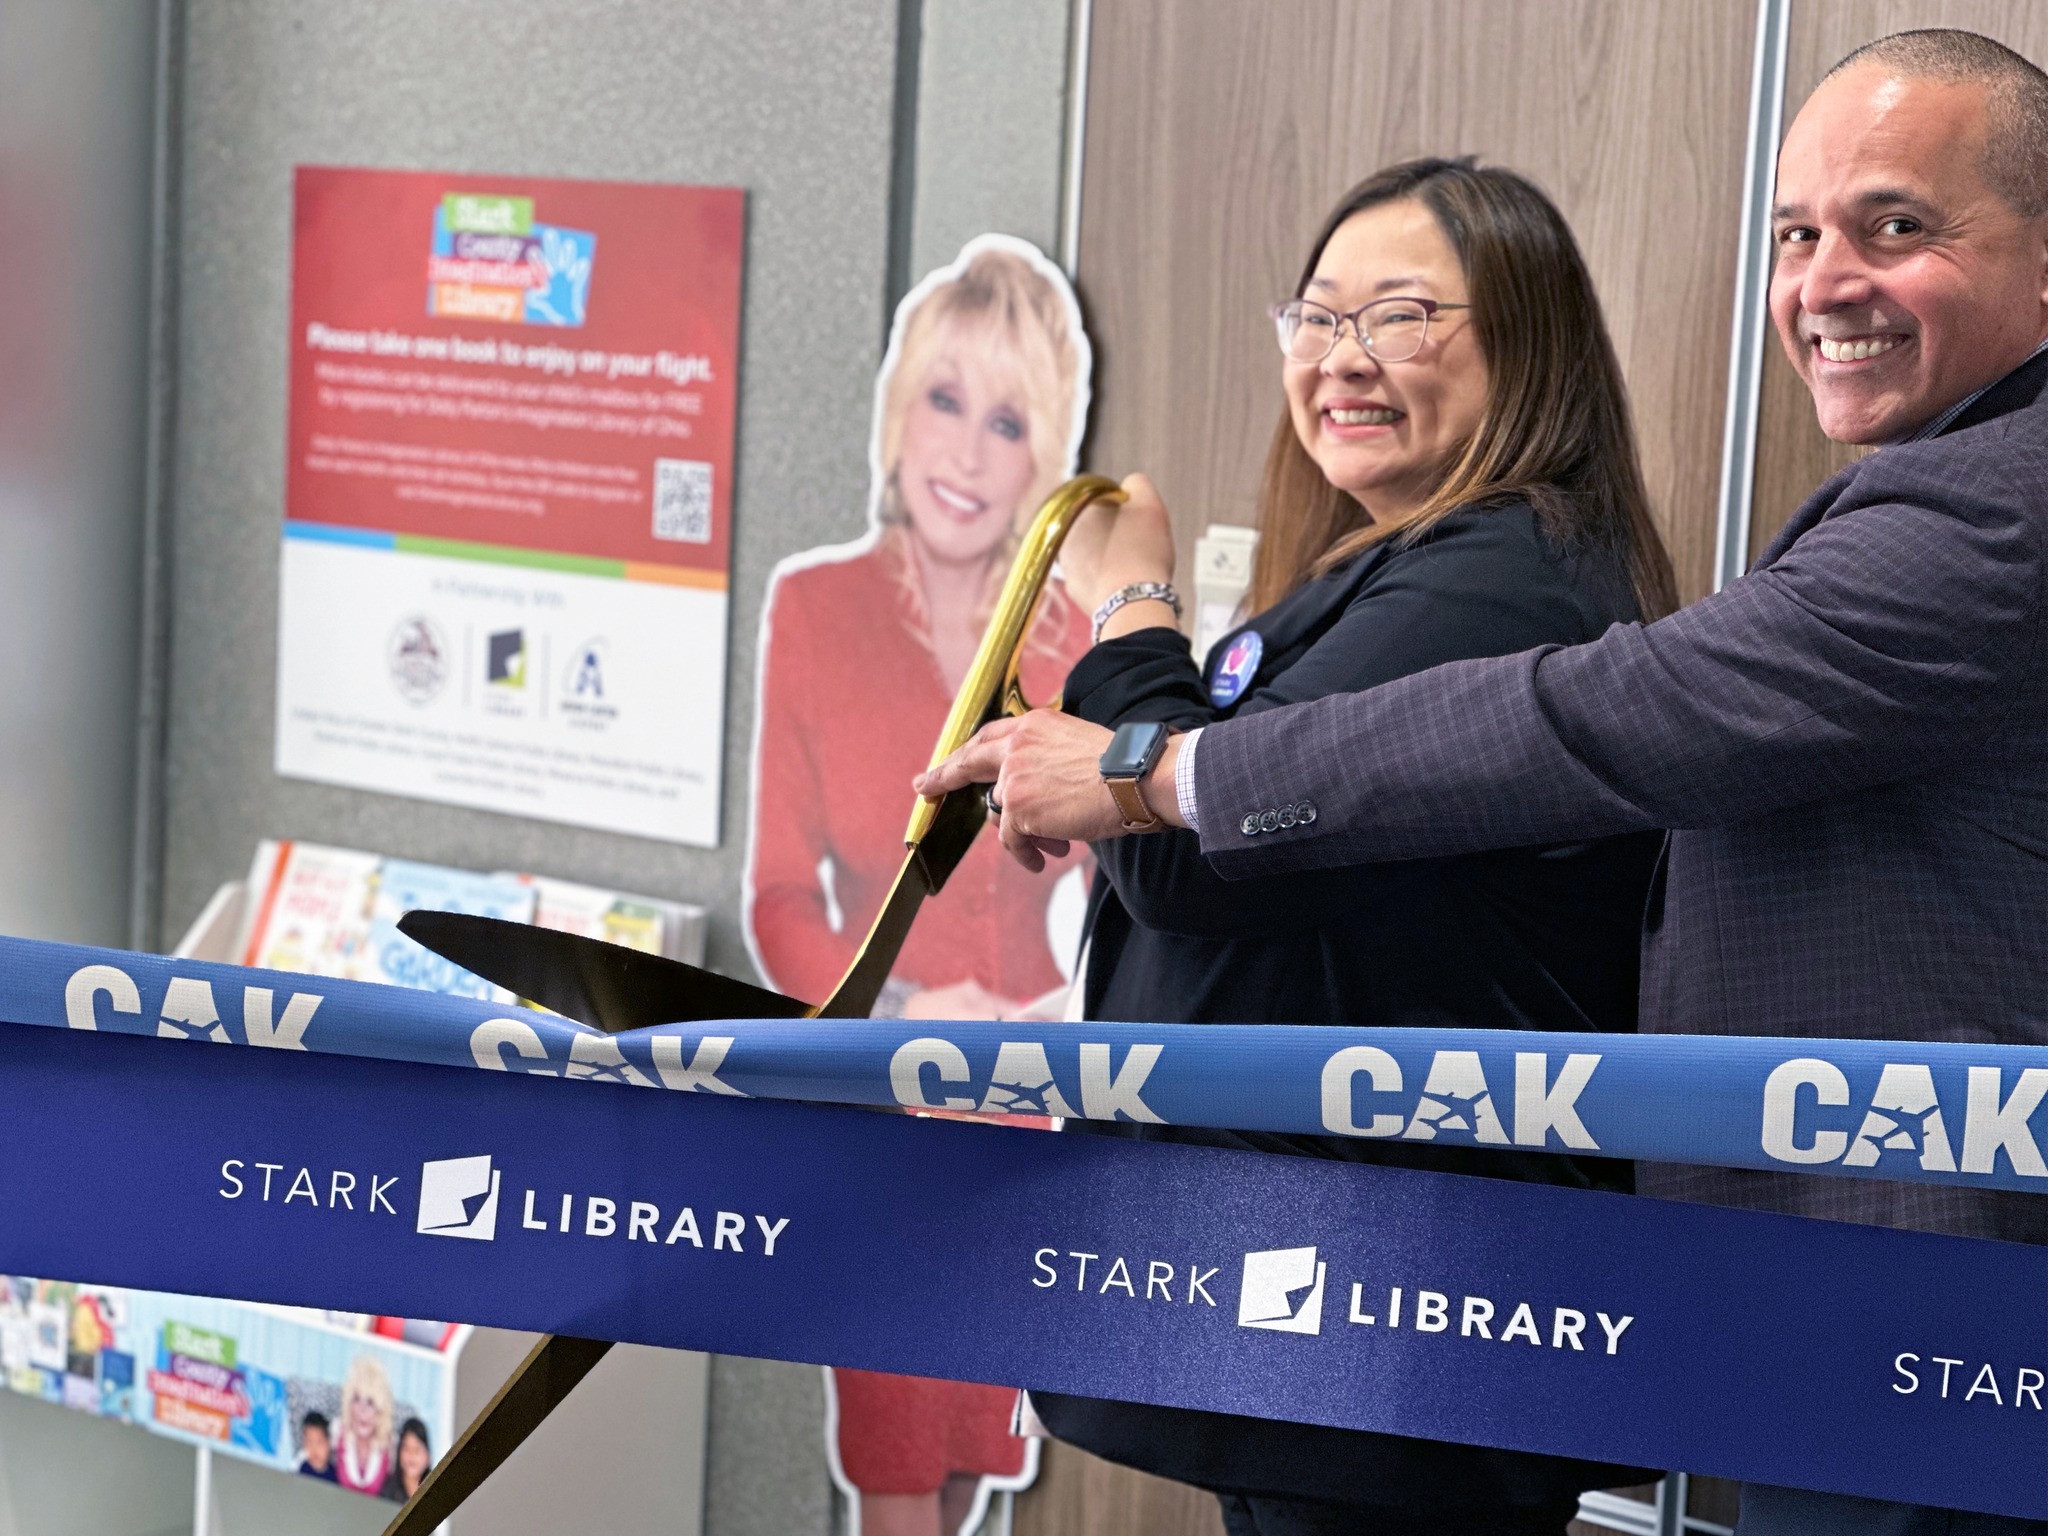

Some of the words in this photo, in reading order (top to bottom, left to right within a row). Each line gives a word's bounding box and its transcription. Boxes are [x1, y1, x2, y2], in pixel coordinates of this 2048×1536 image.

[307, 322, 366, 353] Please
[369, 328, 411, 357] take
[414, 336, 448, 360] one
[450, 333, 497, 364] book
[499, 339, 522, 366] to
[524, 343, 576, 377] enjoy
[578, 350, 606, 373] on
[606, 353, 651, 381] your
[889, 1037, 1167, 1125] CAK
[1321, 1046, 1602, 1150] CAK
[1761, 1057, 2048, 1178] CAK
[219, 1159, 400, 1215] STARK
[522, 1190, 790, 1256] LIBRARY
[1031, 1248, 1219, 1307] STARK
[1349, 1282, 1635, 1355] LIBRARY
